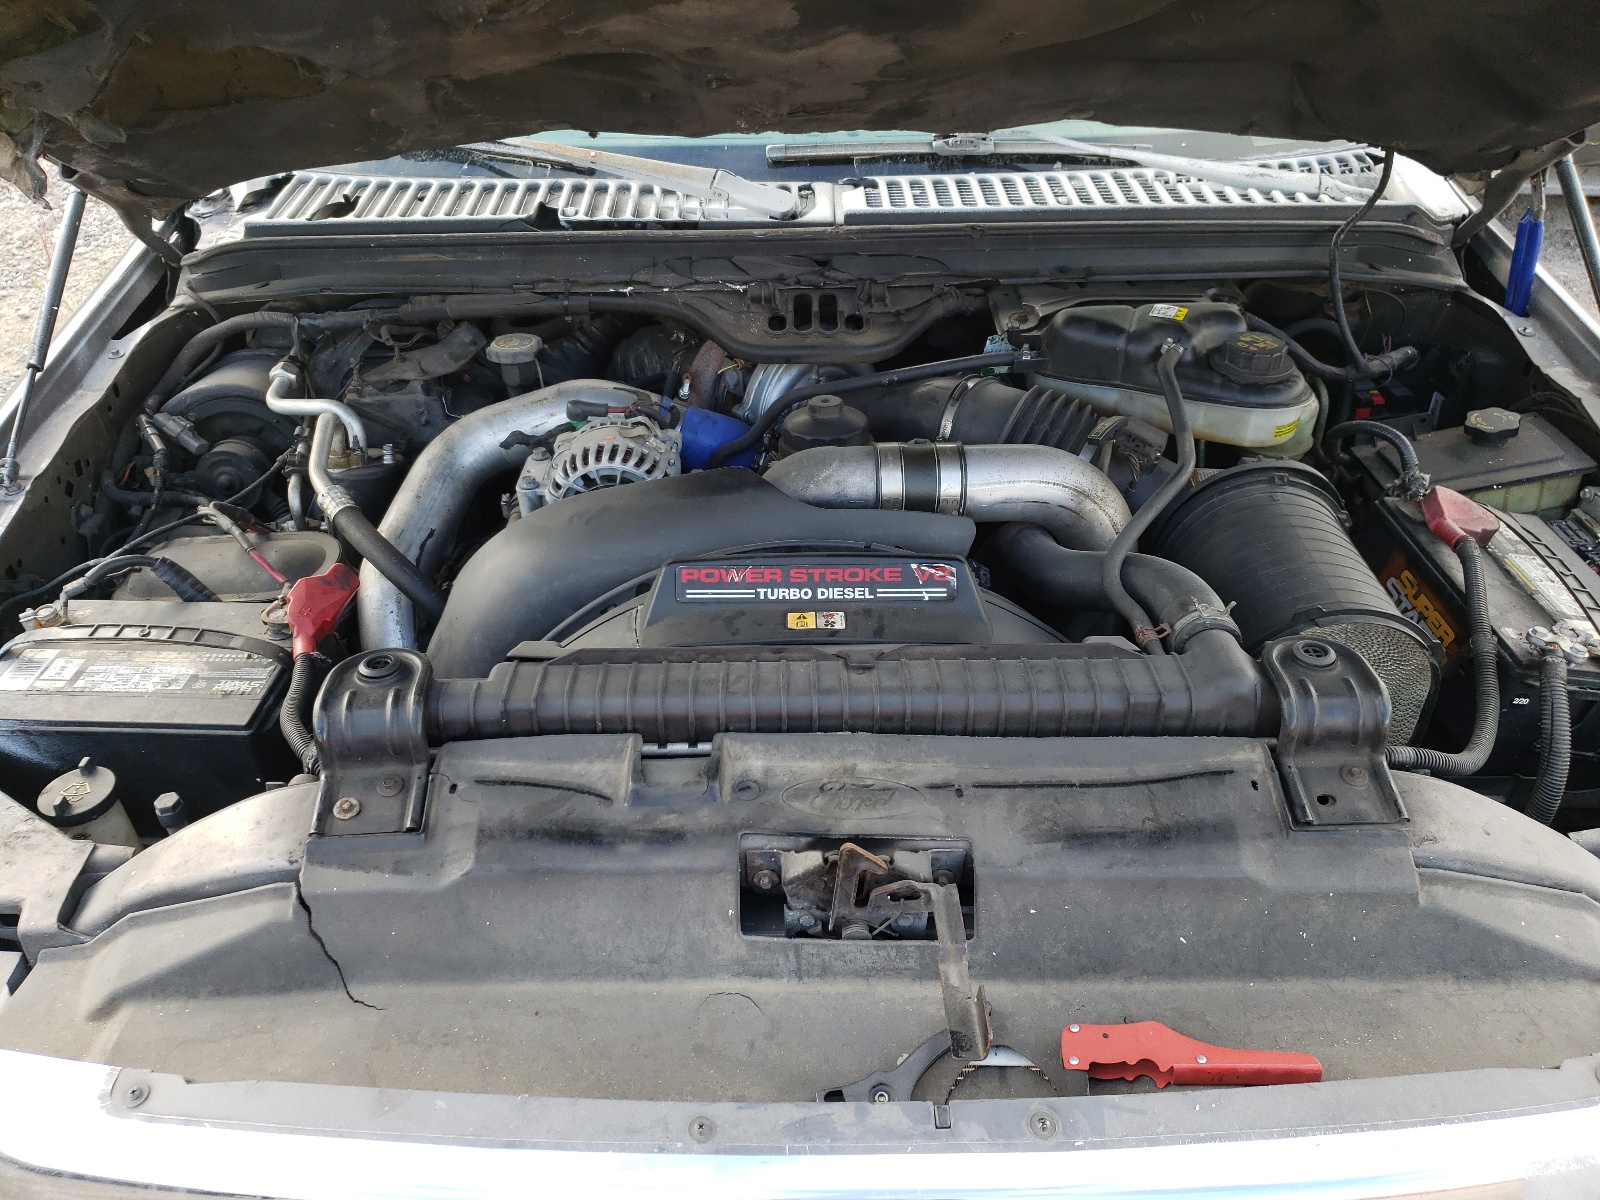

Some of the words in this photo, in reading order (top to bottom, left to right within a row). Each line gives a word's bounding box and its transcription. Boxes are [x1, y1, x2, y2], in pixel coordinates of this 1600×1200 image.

[681, 568, 782, 583] POWER
[789, 567, 903, 582] STROKE
[913, 566, 952, 582] V8
[757, 588, 812, 600] TURBO
[817, 588, 875, 599] DIESEL
[1395, 570, 1456, 648] SUPER
